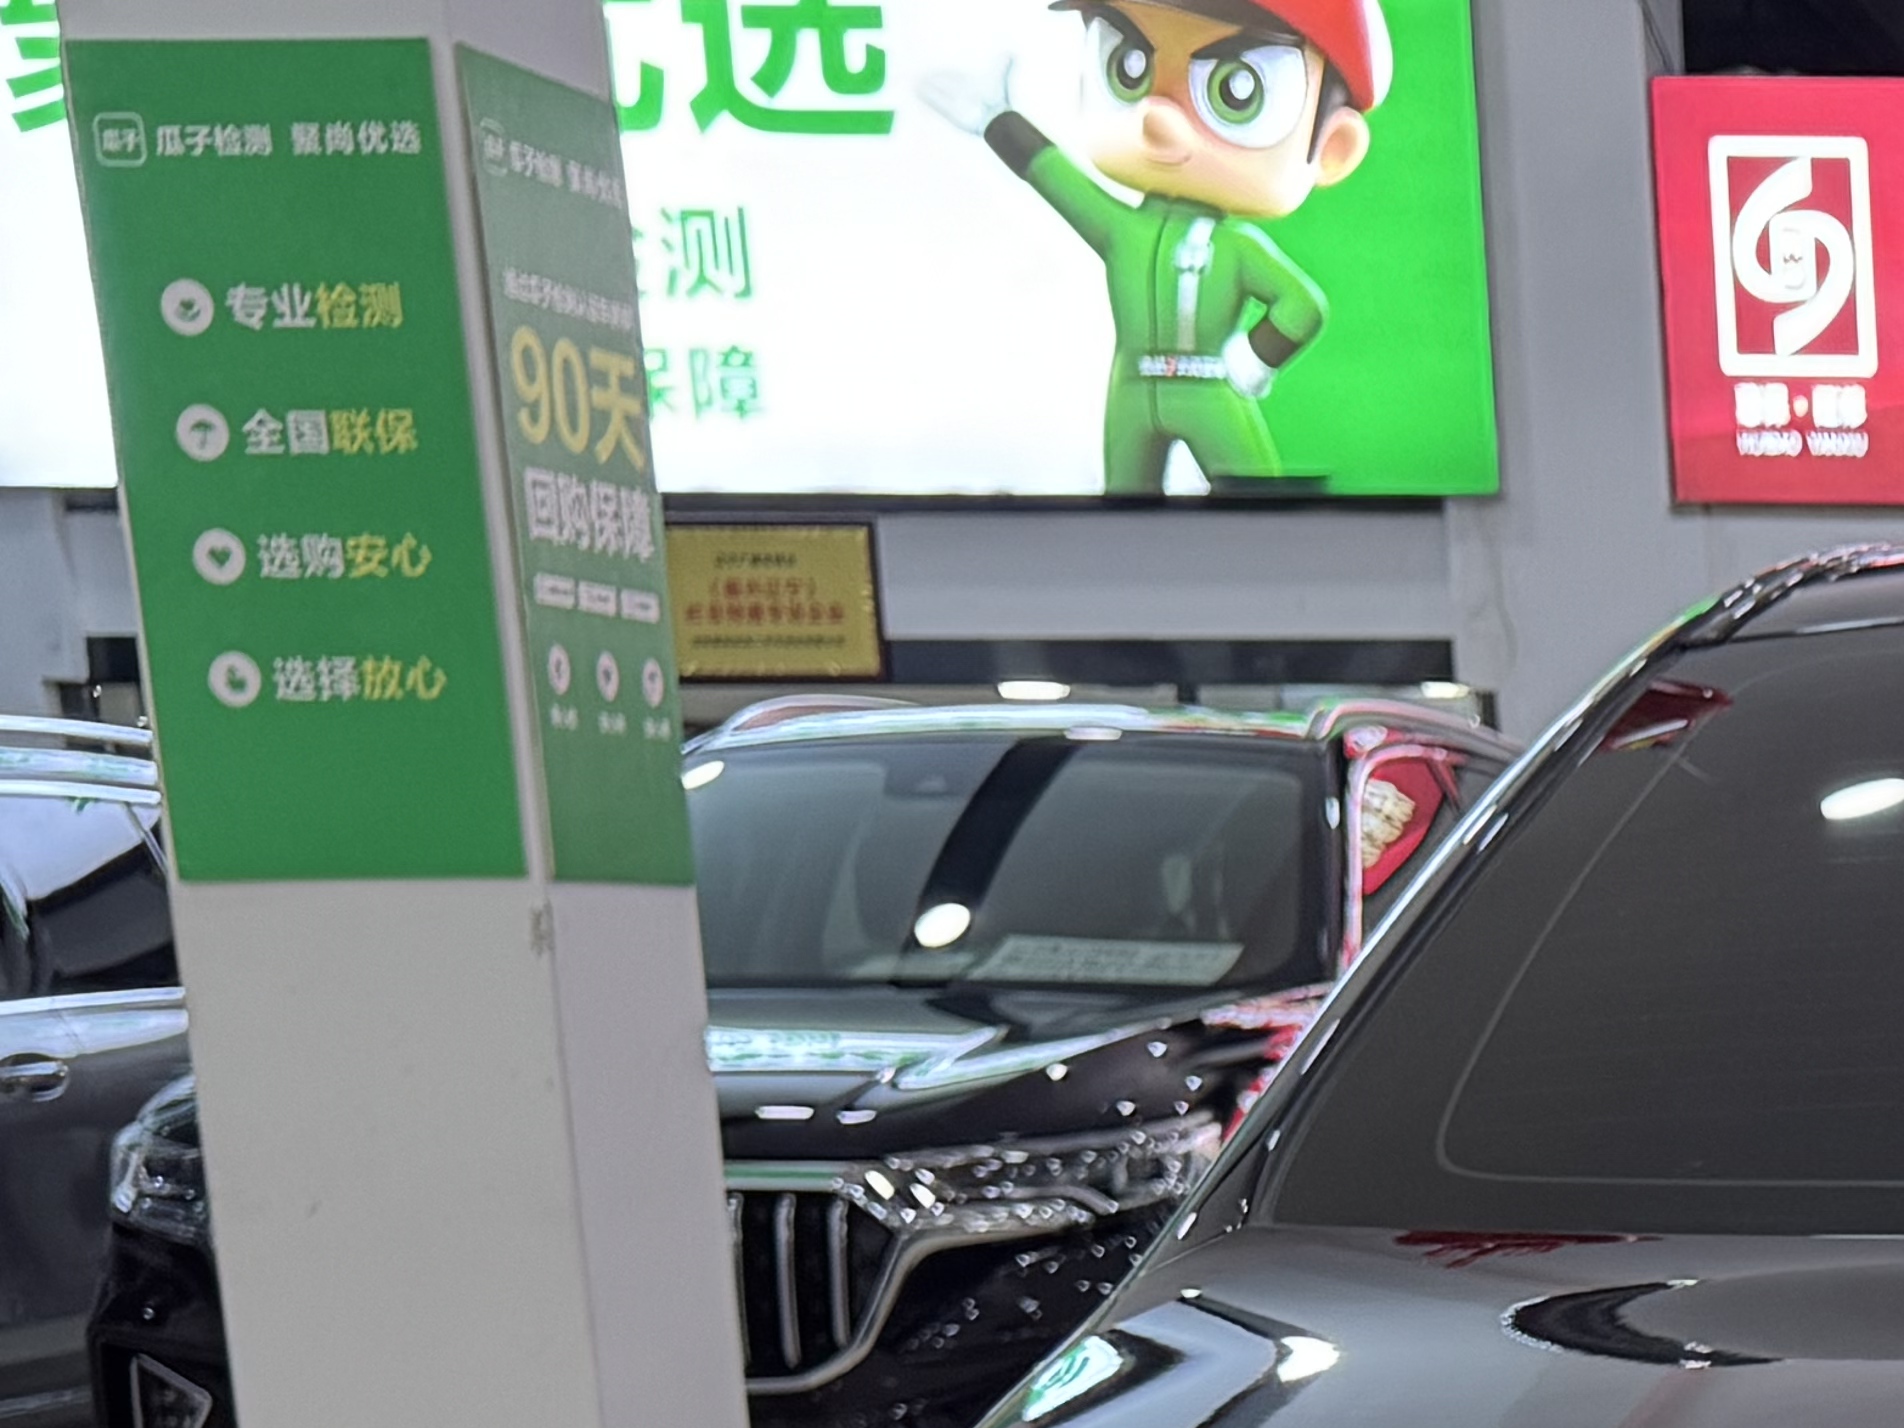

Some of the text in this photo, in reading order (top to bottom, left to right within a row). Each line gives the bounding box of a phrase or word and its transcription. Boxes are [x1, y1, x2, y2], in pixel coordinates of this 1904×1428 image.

[155, 120, 423, 156] 瓜子检测 聚尚优选
[226, 282, 404, 331] 专业检测
[511, 325, 647, 474] 90天
[241, 407, 419, 456] 全国联保
[524, 466, 655, 564] 回购保障
[258, 532, 432, 580] 选购安心
[273, 656, 448, 703] 选择放心
